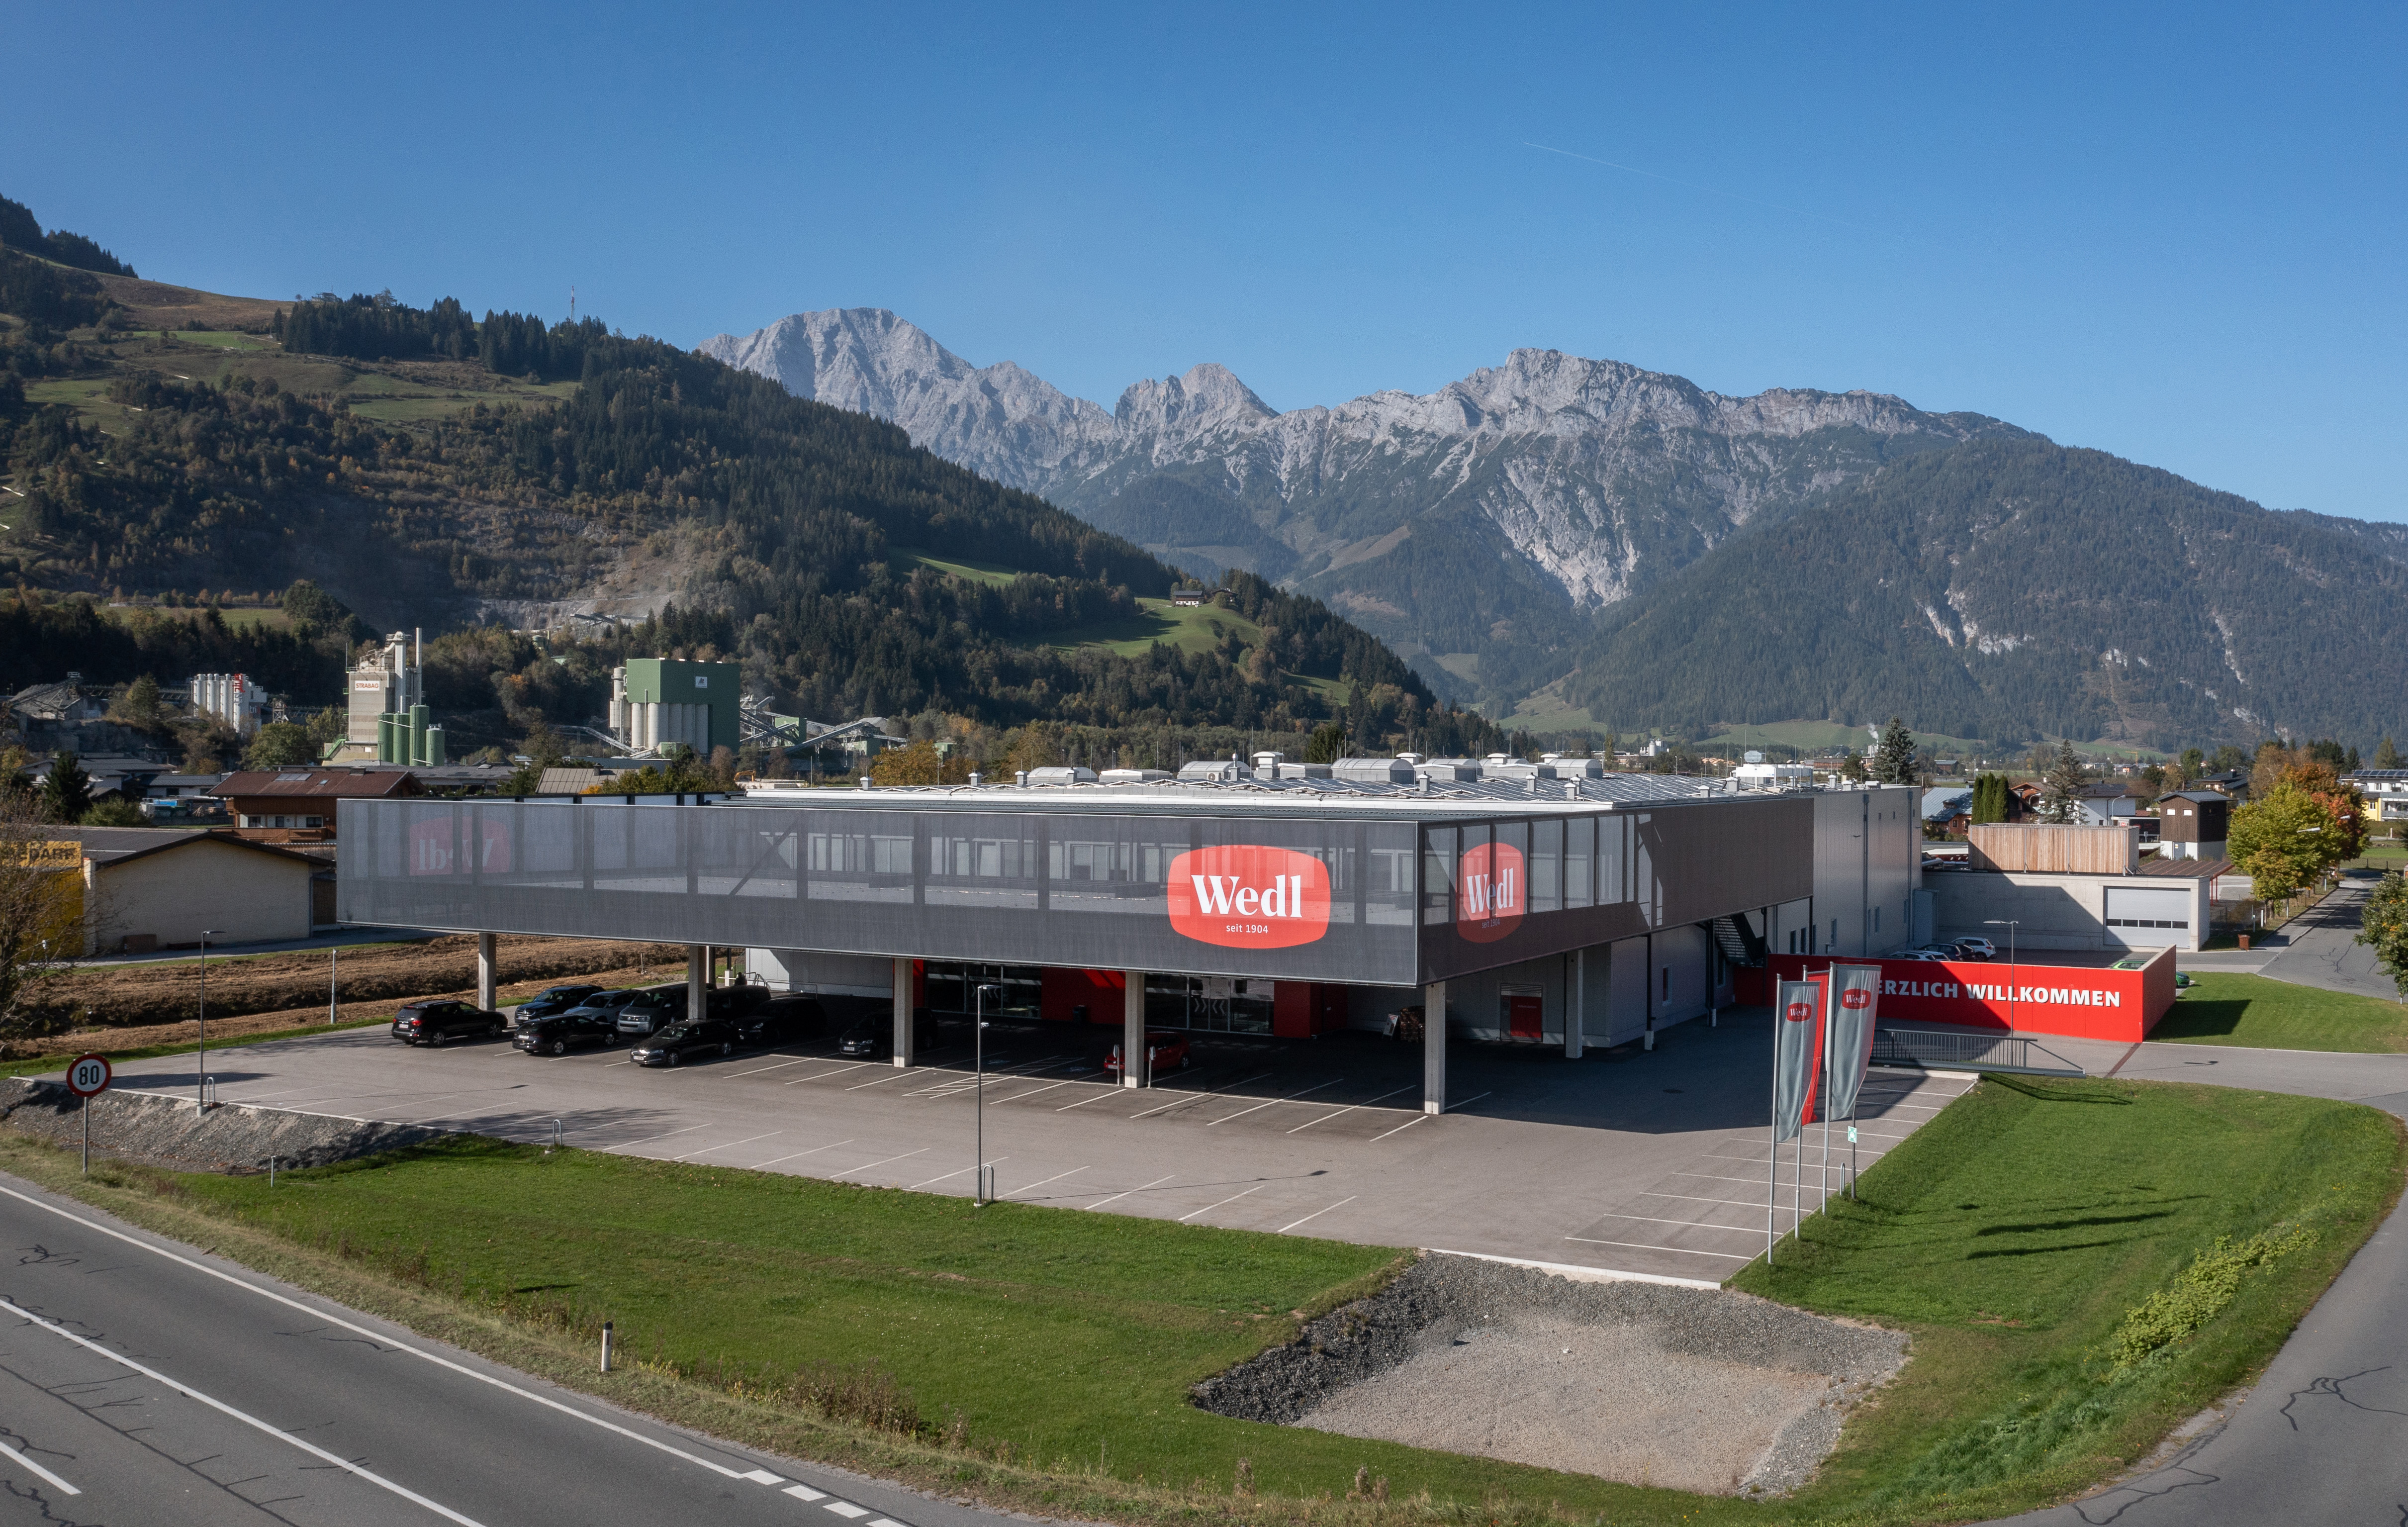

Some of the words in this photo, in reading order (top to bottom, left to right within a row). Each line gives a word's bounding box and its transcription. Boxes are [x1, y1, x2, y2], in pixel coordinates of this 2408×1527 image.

[1191, 874, 1302, 917] Wedl
[1467, 867, 1513, 913] Wedl
[1226, 924, 1242, 933] seit
[1246, 925, 1268, 933] 1904
[1490, 918, 1500, 927] 1904
[1846, 994, 1866, 1004] Wedl
[1966, 984, 2120, 1007] WILLKOMMEN
[1790, 1008, 1807, 1016] Wedl
[80, 1065, 99, 1085] 80
